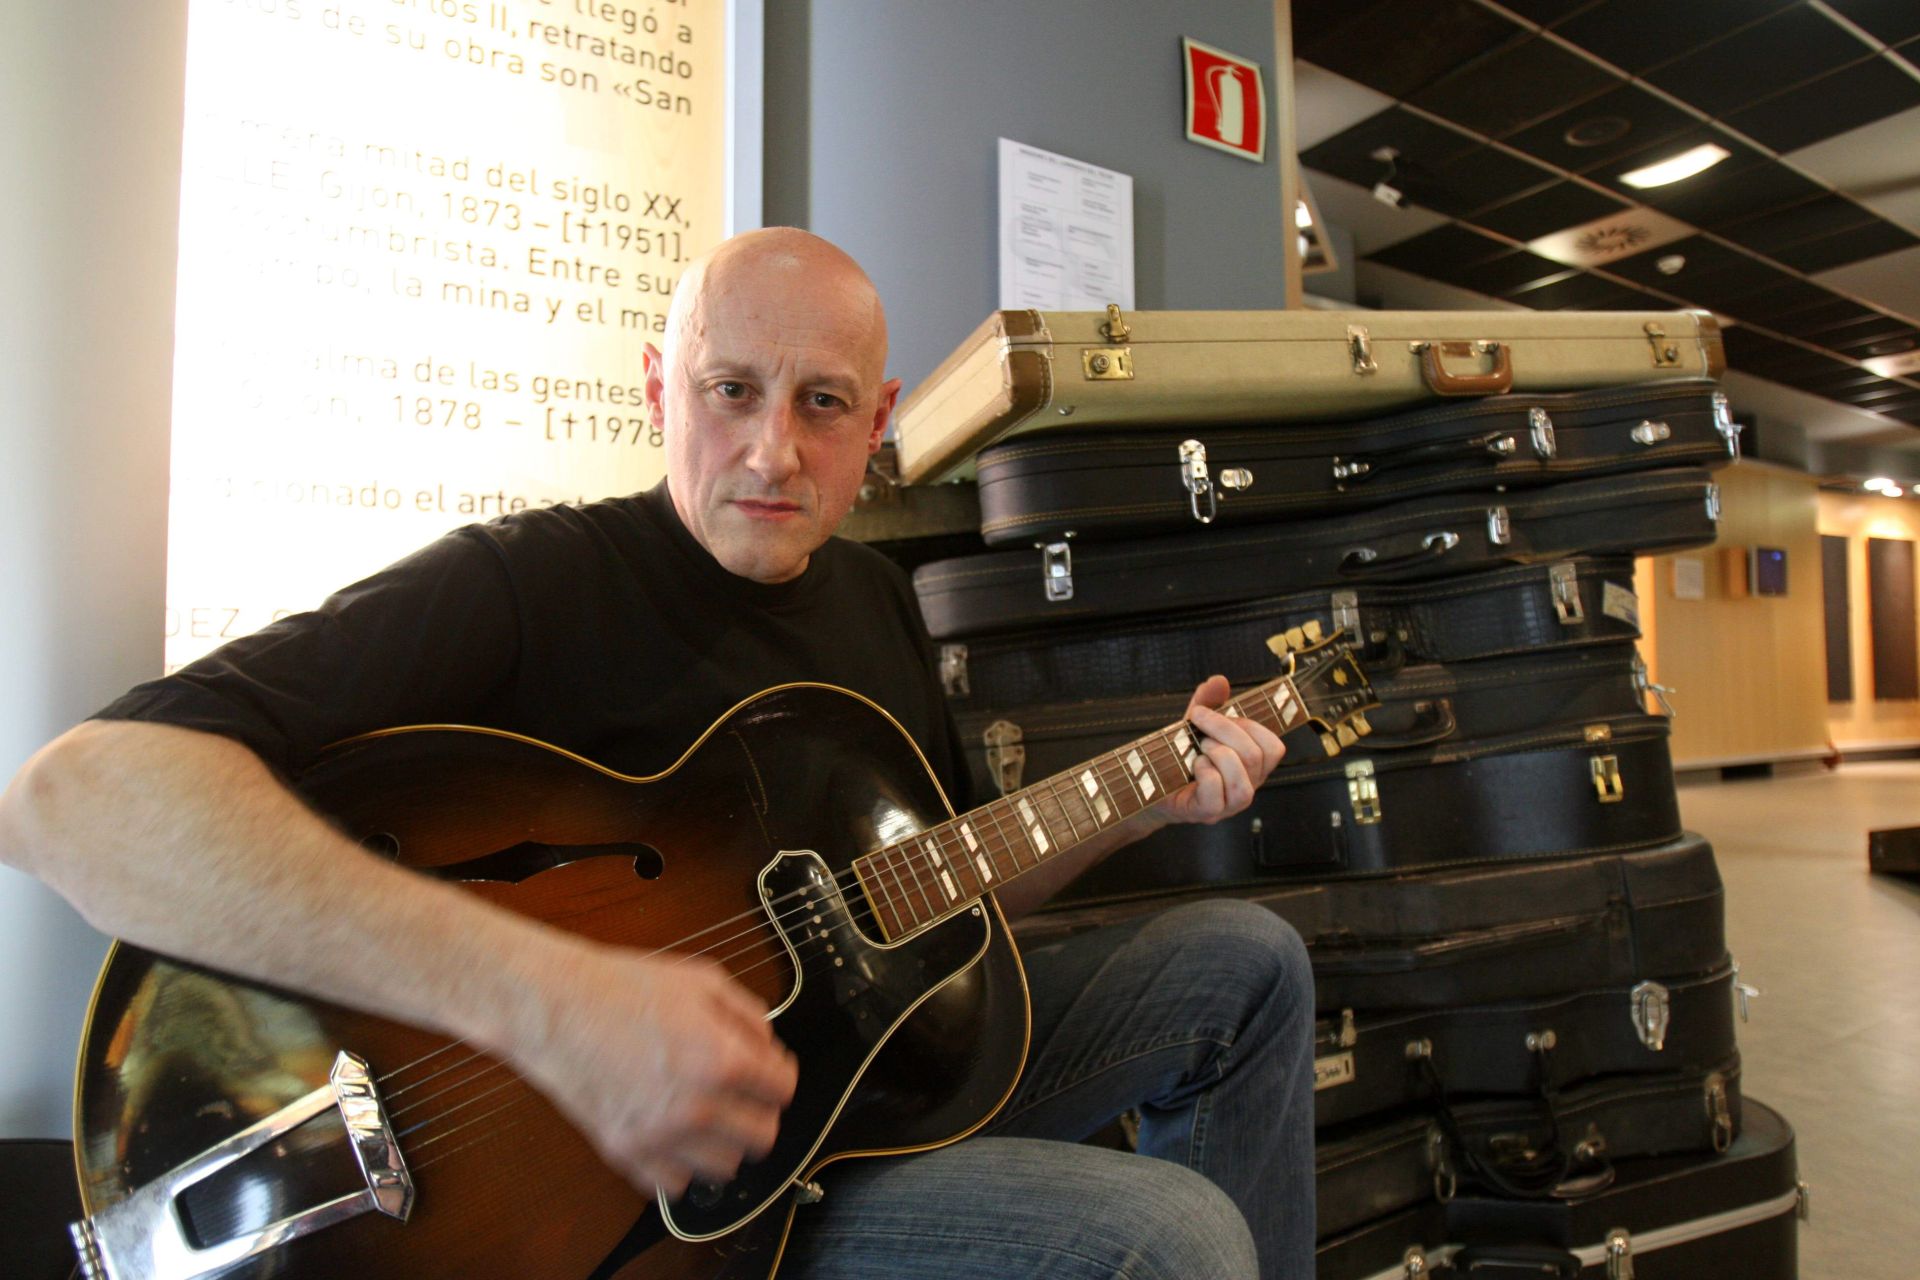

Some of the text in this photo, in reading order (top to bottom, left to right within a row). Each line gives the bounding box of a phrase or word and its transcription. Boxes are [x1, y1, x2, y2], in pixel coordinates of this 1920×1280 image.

[322, 4, 366, 36] de
[385, 23, 426, 51] su
[444, 35, 525, 76] obra
[540, 60, 599, 94] son
[528, 19, 694, 80] retratando
[676, 24, 693, 45] a
[364, 142, 692, 230] mitad del siglo XX,
[442, 191, 522, 231] 1873
[528, 246, 621, 288] Entre
[392, 266, 423, 298] la
[442, 279, 531, 313] mina
[545, 296, 563, 325] y
[576, 297, 607, 325] el
[620, 308, 667, 335] ma
[413, 355, 456, 387] de
[469, 360, 521, 394] las
[531, 375, 644, 407] gentes
[393, 394, 482, 431] 1878
[414, 482, 446, 513] el
[457, 489, 528, 515] arte
